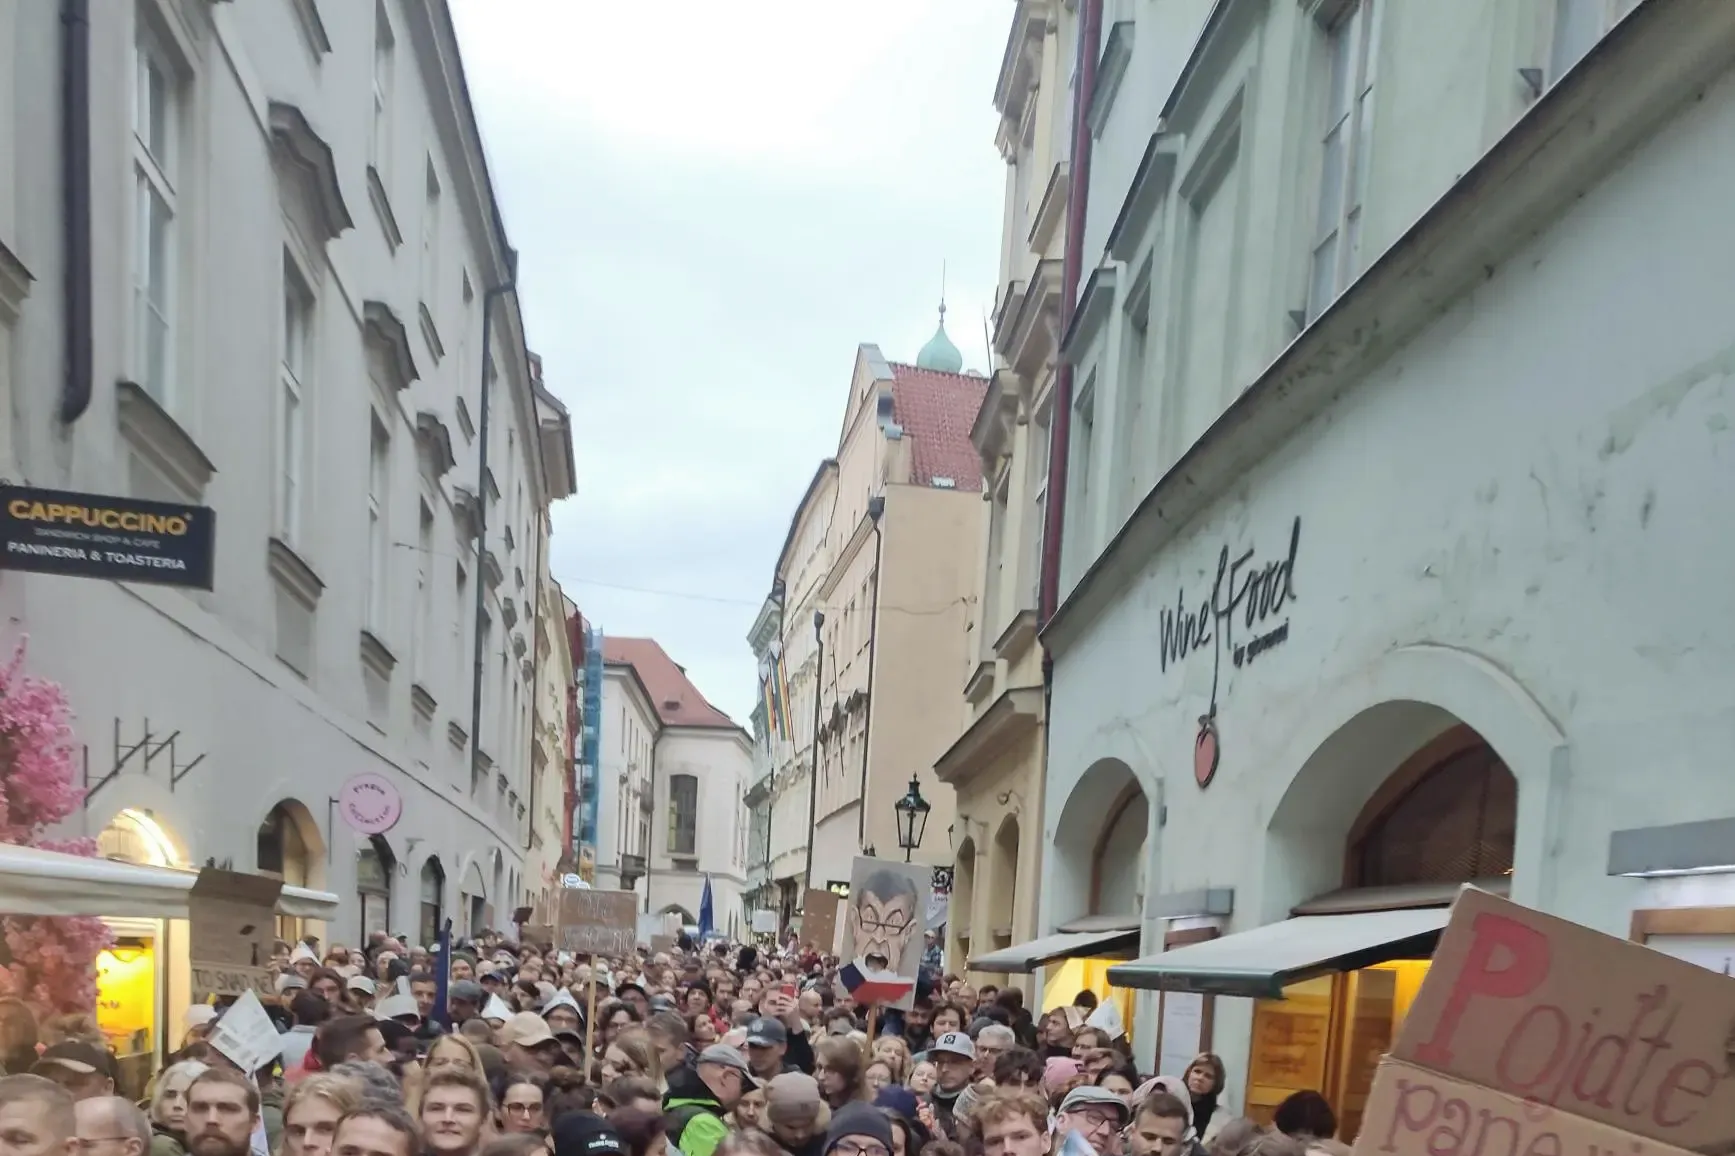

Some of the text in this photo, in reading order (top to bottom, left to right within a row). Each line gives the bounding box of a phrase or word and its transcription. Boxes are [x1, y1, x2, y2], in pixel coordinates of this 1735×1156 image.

[7, 541, 186, 570] PANINERIA & TOASTERIA
[1160, 586, 1211, 673] Wine
[1228, 515, 1300, 650] Food
